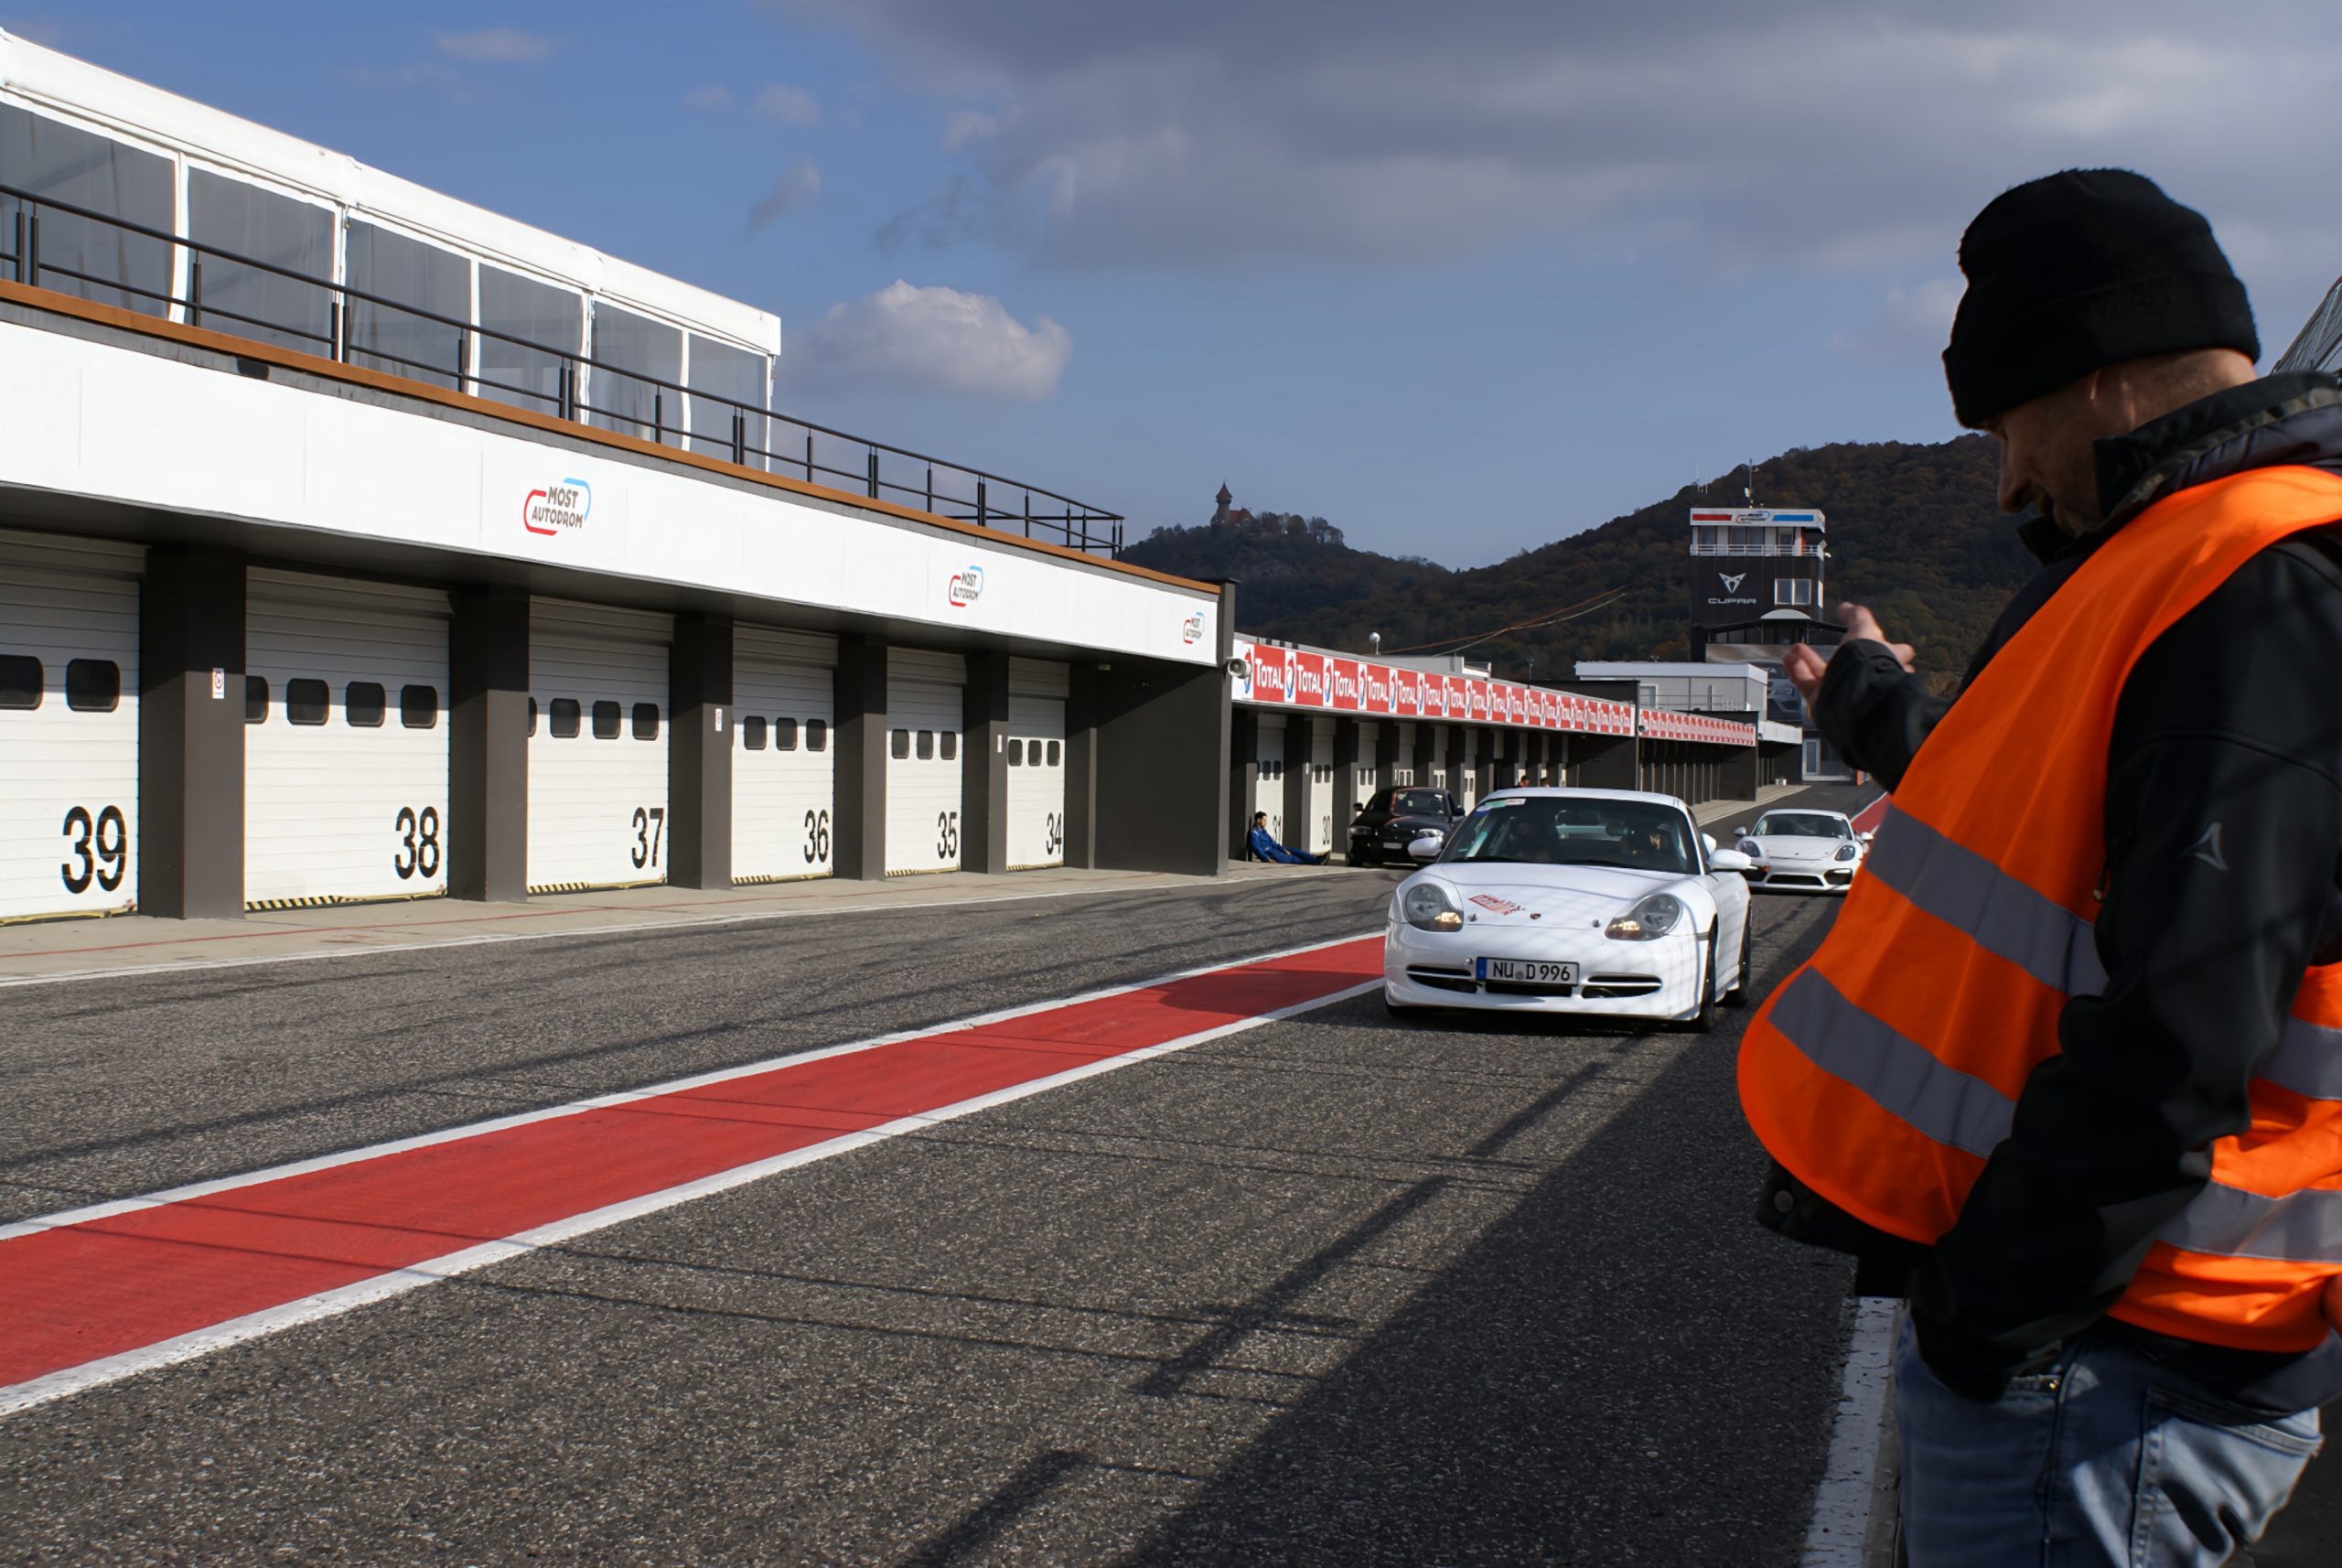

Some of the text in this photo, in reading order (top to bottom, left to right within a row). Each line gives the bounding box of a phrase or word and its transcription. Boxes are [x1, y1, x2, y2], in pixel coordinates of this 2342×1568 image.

[532, 506, 583, 529] AUTODROM
[548, 486, 578, 509] MOST
[962, 572, 976, 586] MOST
[1254, 658, 1284, 690] TOTAL
[1296, 663, 1322, 694] TOTAL
[1334, 670, 1357, 698] TOTAL
[1367, 675, 1389, 702] TOTAL
[1398, 680, 1417, 704] TOTAL
[1425, 683, 1443, 707] TOTAL
[62, 805, 127, 894] 39
[394, 806, 440, 880] 38
[631, 807, 664, 869] 37
[803, 810, 829, 864] 36
[937, 811, 957, 860] 35
[1046, 812, 1062, 855] 34
[1322, 815, 1331, 845] 30
[1493, 961, 1571, 982] NU D 996
